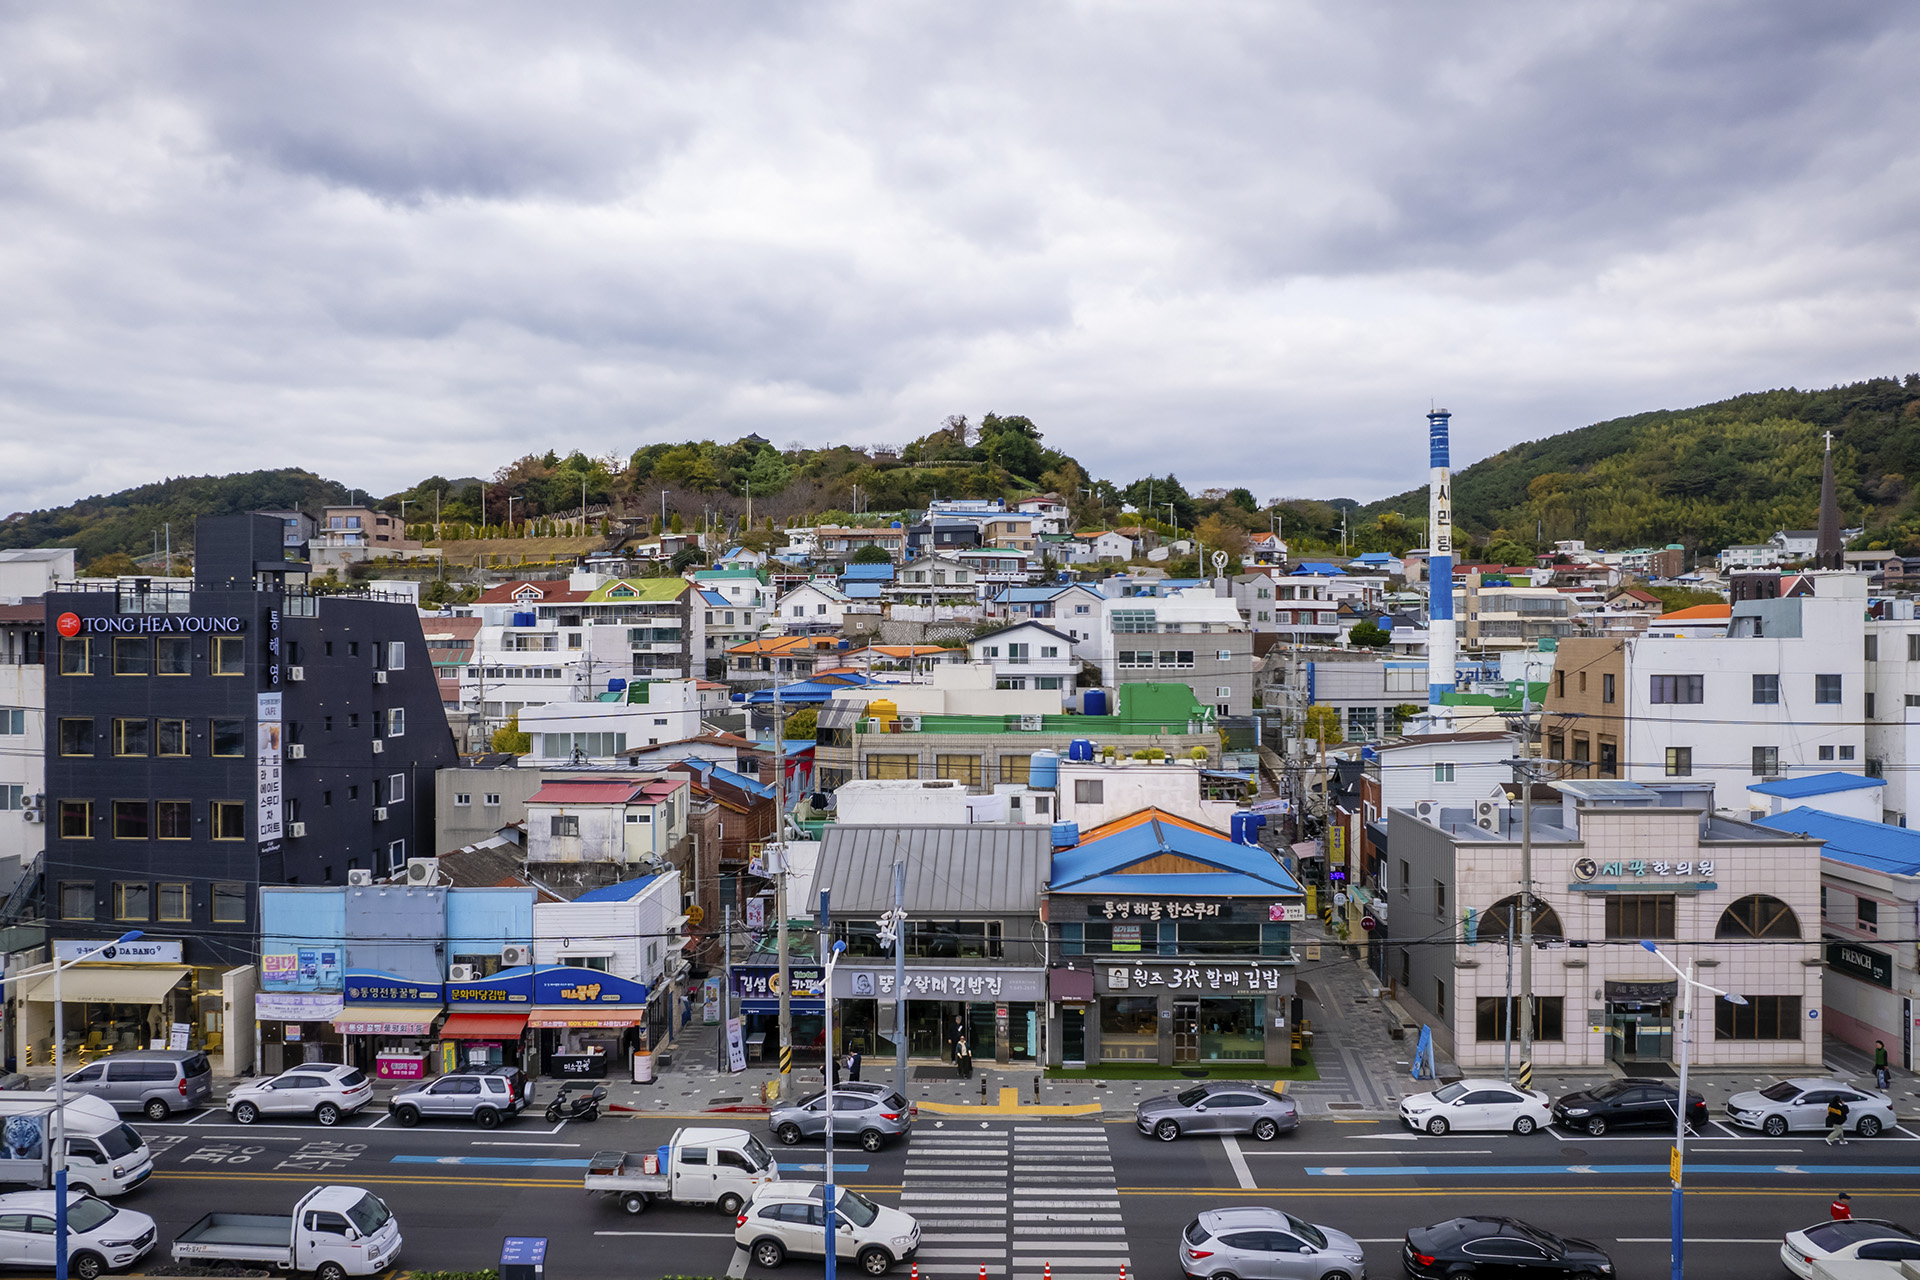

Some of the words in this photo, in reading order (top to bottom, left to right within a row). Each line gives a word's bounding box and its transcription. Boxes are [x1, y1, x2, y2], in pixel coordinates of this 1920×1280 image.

[1438, 485, 1450, 551] 시민탕
[82, 617, 135, 632] TONG
[139, 615, 173, 633] HEA
[176, 616, 240, 632] YOUNG
[269, 610, 280, 684] 통해영
[260, 782, 279, 794] 에이드
[261, 795, 279, 808] 스무디
[266, 810, 273, 820] 차
[261, 822, 280, 835] 디저트
[1102, 901, 1130, 919] 통영
[1133, 901, 1163, 920] 해물
[1166, 901, 1221, 920] 한소쿠리
[264, 956, 296, 970] 임대
[1841, 947, 1872, 970] FRENCH
[1132, 968, 1165, 988] 원조
[1205, 968, 1239, 989] 할매
[1244, 968, 1280, 989] 김밥
[451, 989, 507, 1001] 문화마당김밥
[561, 983, 601, 1001] 미소꿀빵
[349, 1024, 364, 1033] 통영
[366, 1024, 382, 1032] 꿀빵
